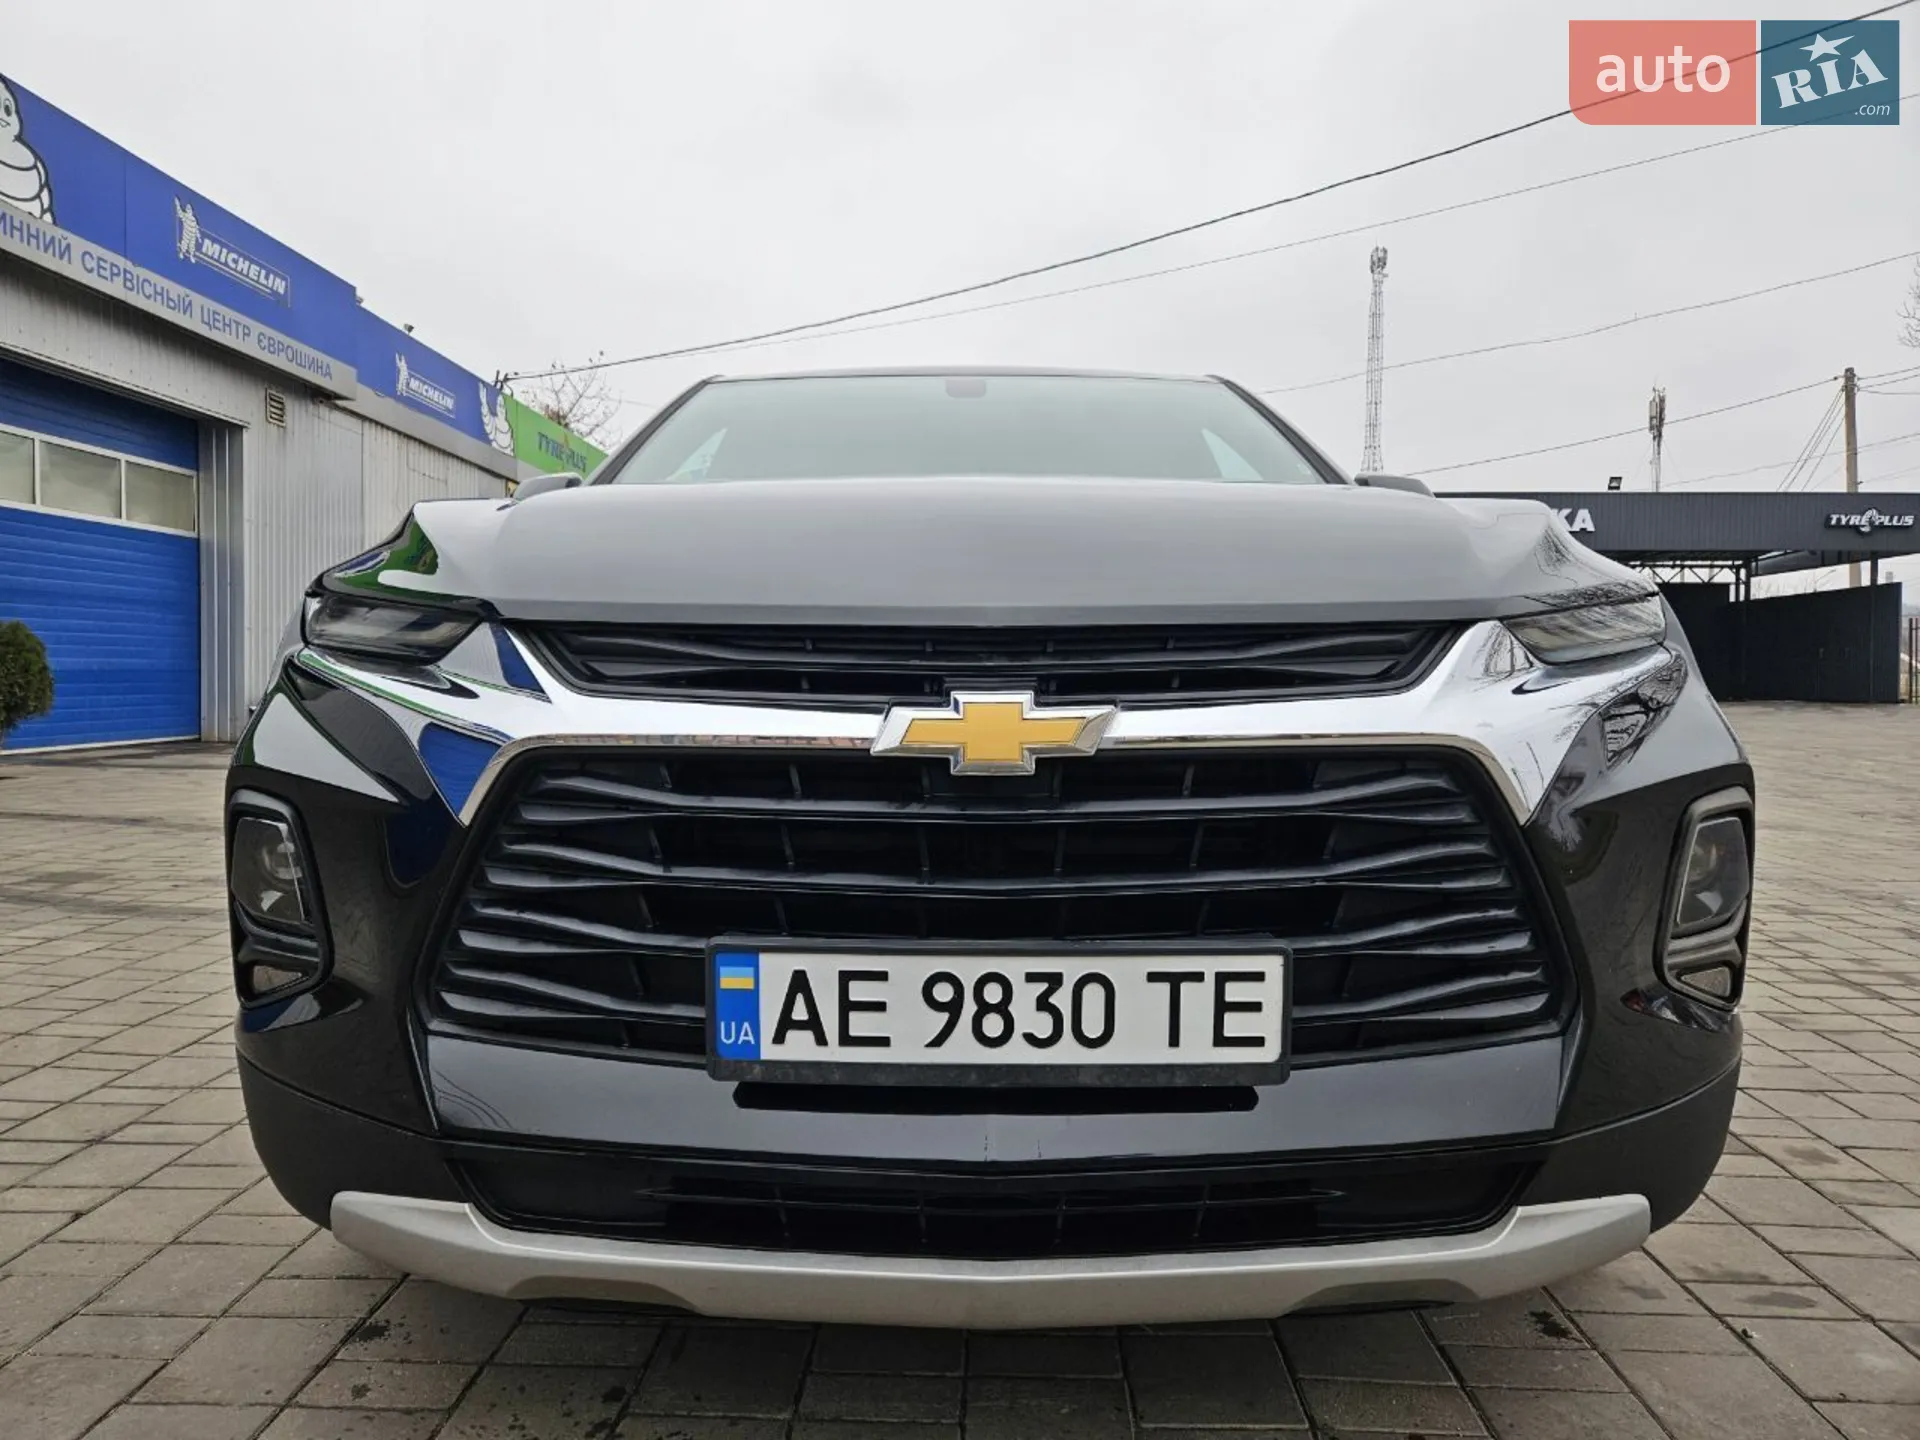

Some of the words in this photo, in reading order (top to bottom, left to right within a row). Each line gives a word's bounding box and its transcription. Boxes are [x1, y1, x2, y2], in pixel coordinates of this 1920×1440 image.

[201, 237, 287, 296] MICHELIN
[201, 304, 252, 342] ЦЕНТР
[257, 331, 333, 381] ЄВРОШИНА
[409, 377, 455, 411] MICHELIN
[720, 1021, 756, 1045] UA
[771, 969, 892, 1048] AE
[921, 970, 1117, 1049] 9830
[1146, 970, 1266, 1048] TE
